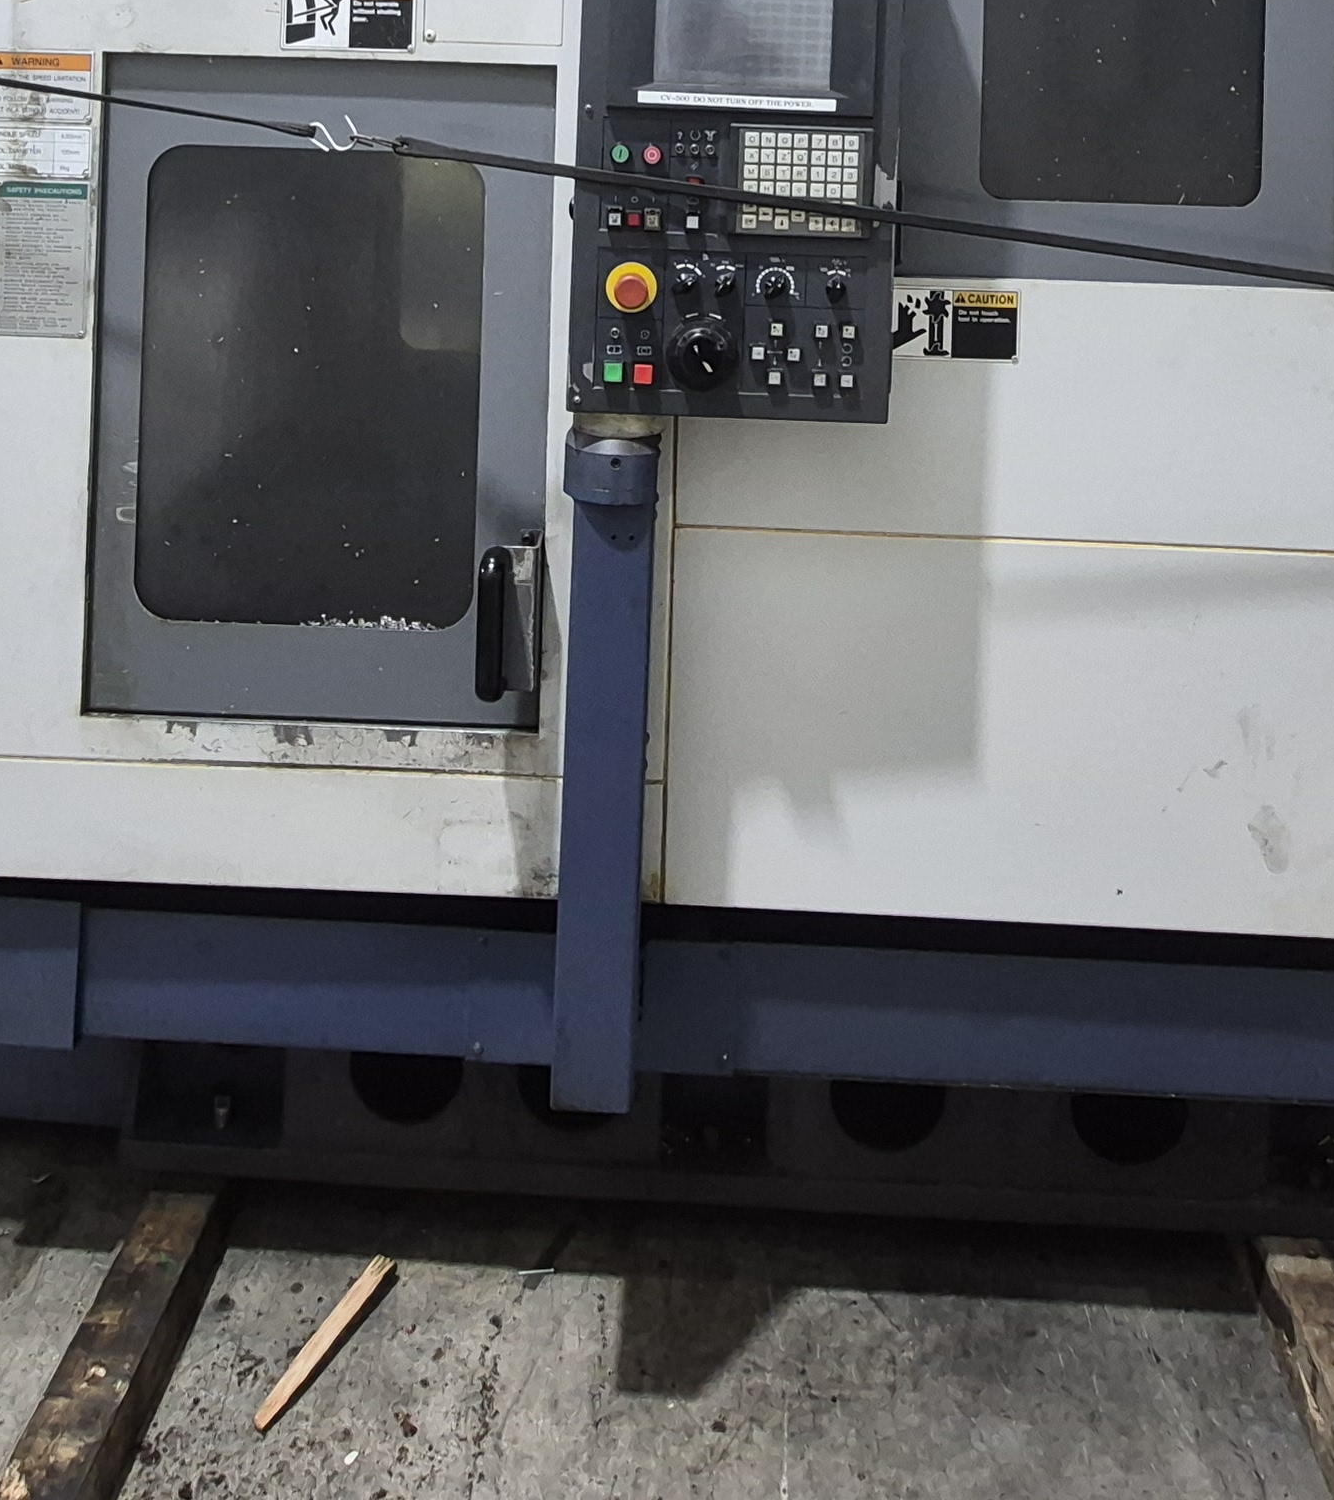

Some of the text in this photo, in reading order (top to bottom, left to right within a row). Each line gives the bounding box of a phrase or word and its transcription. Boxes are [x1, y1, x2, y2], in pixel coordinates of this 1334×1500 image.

[11, 56, 60, 67] WARNING
[693, 95, 706, 103] DO
[707, 96, 724, 104] NOT
[726, 97, 746, 105] TURN
[748, 98, 765, 106] OFF
[766, 99, 782, 107] THE
[967, 293, 1014, 305] CAUTION
